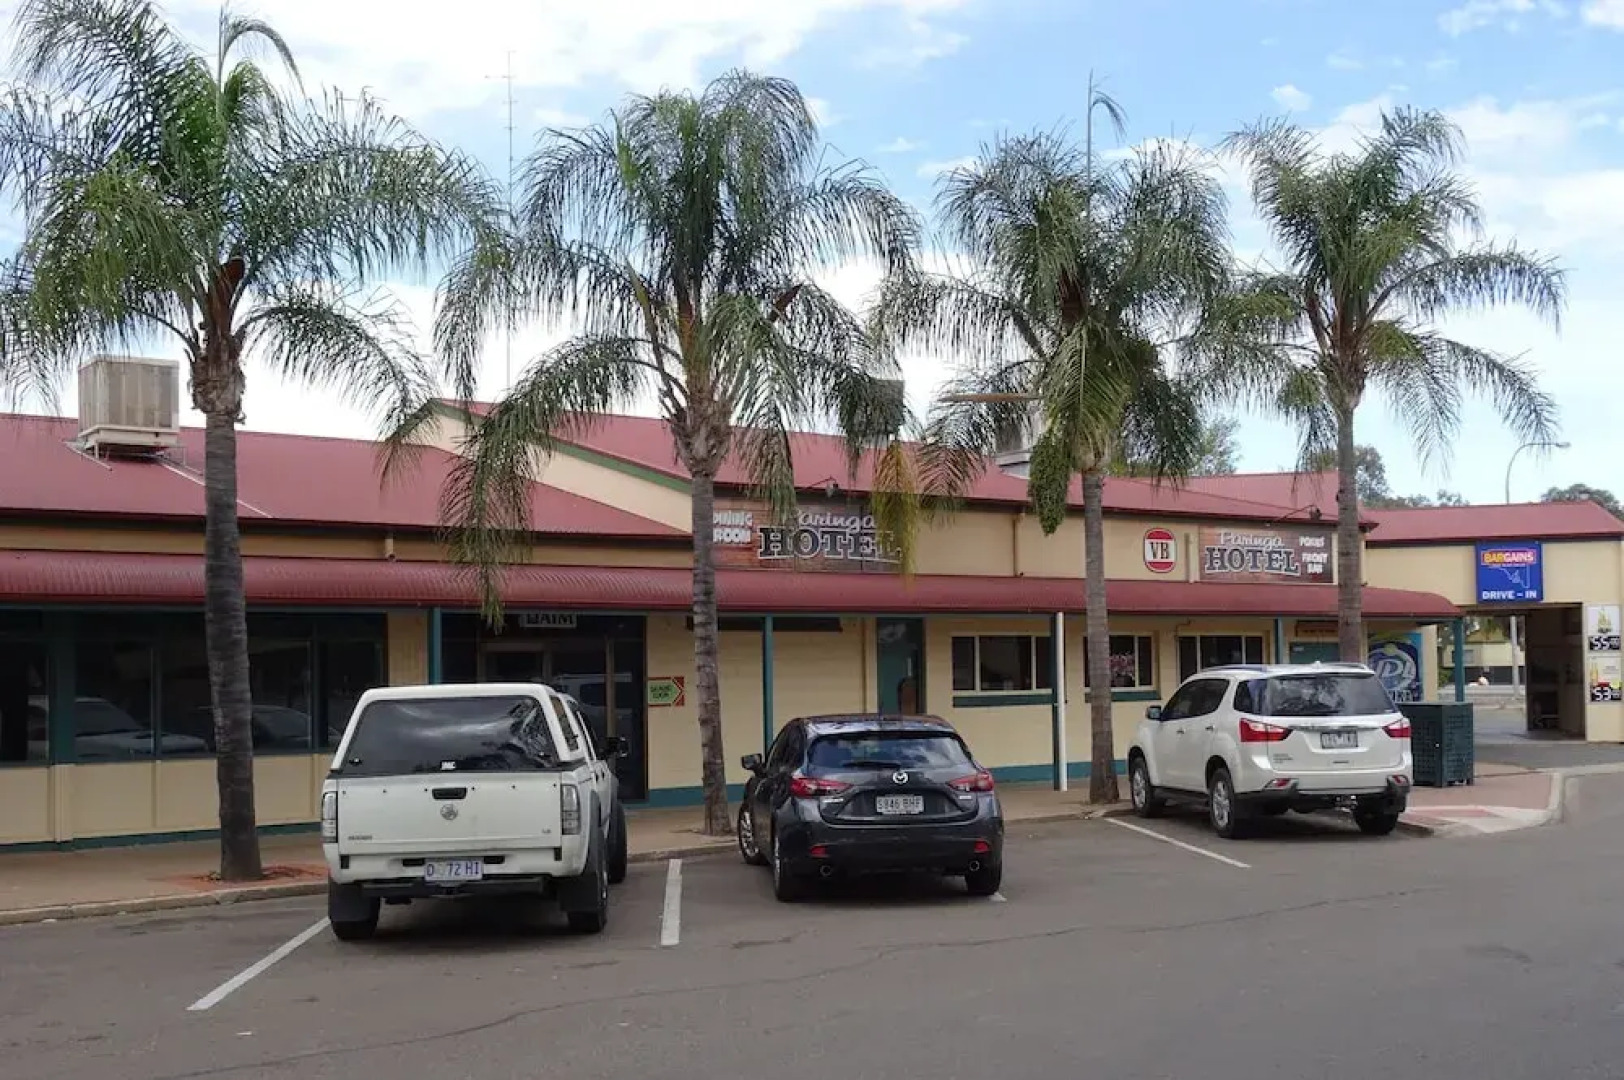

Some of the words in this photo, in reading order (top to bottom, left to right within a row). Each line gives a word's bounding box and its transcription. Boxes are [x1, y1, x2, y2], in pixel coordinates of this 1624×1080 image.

[798, 511, 876, 533] aringa
[757, 526, 901, 563] HOTEL
[1150, 542, 1169, 559] VB
[1205, 546, 1300, 576] HOTEL
[1484, 551, 1534, 563] BARGAINS
[1482, 590, 1516, 600] DRIVE
[1524, 590, 1537, 599] IN
